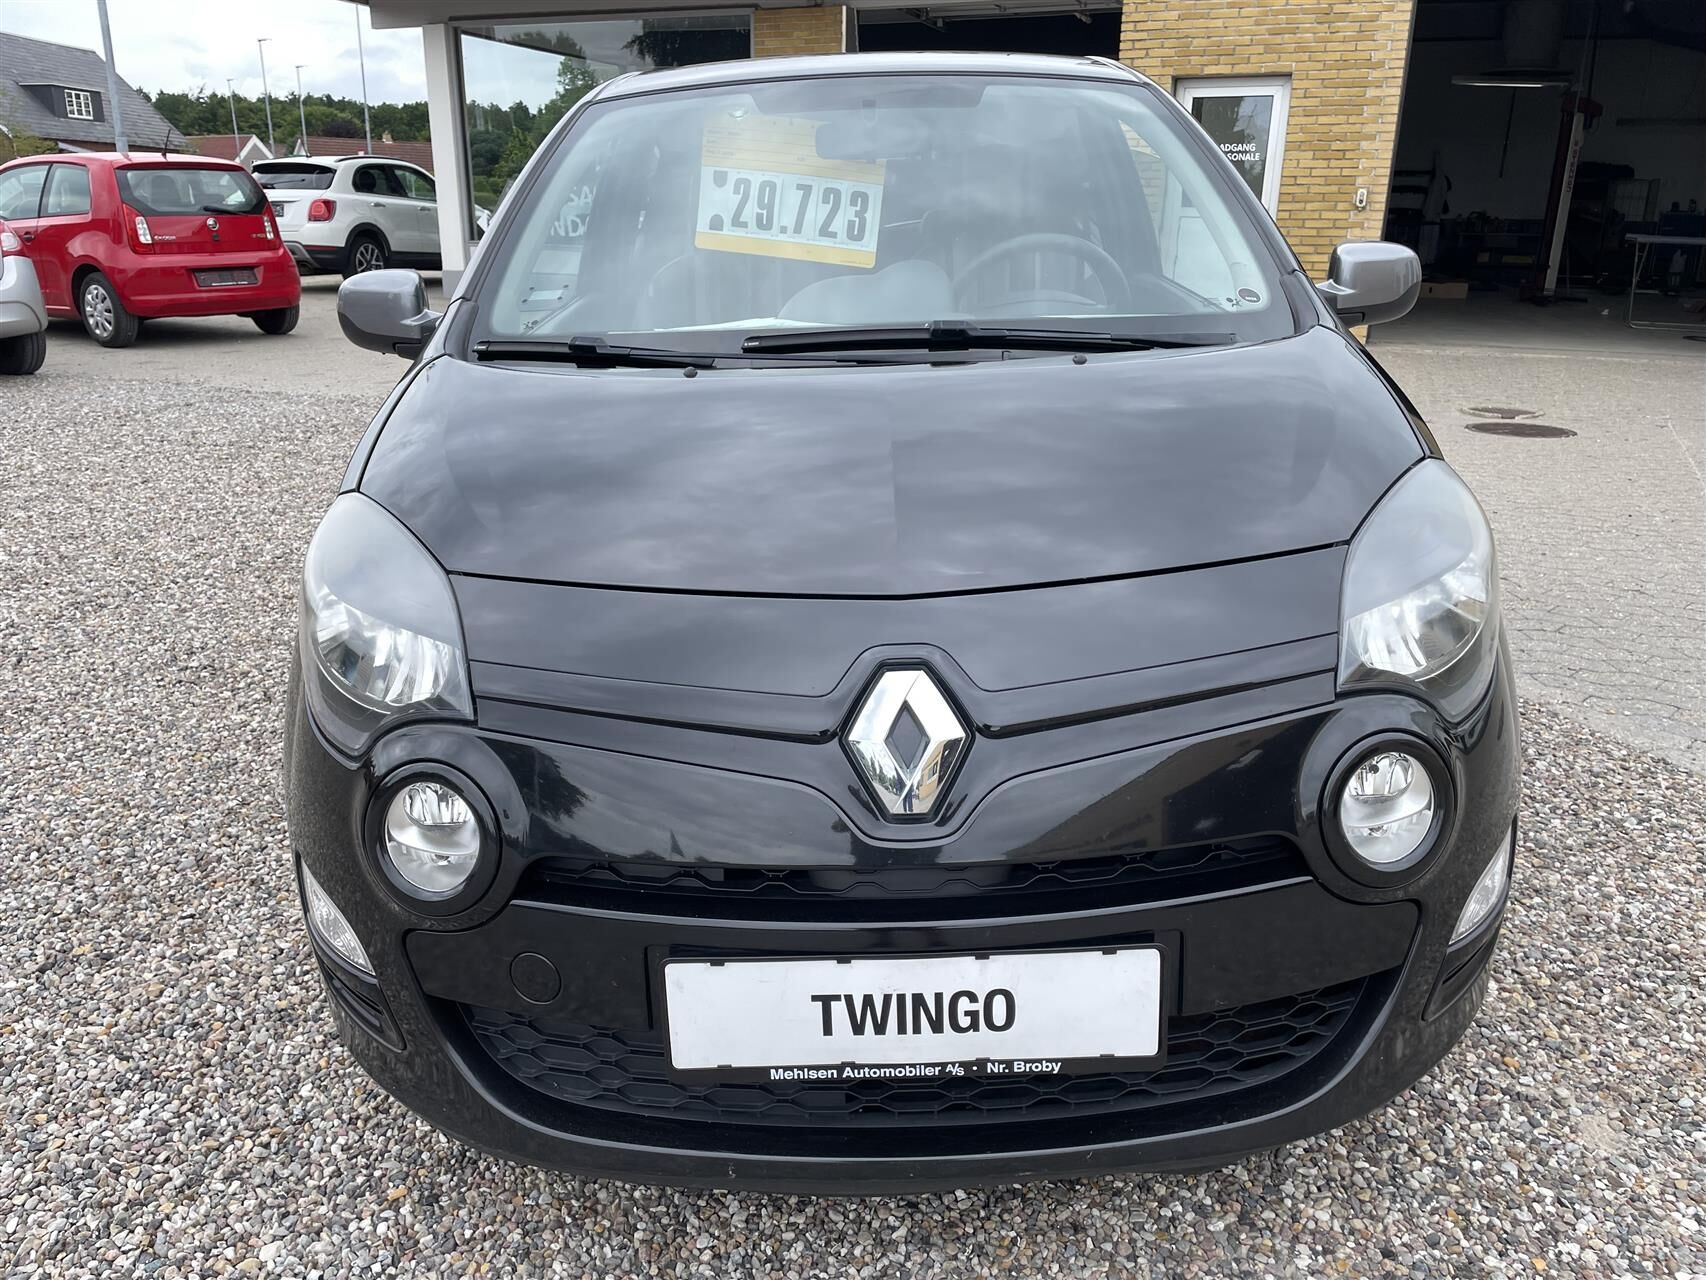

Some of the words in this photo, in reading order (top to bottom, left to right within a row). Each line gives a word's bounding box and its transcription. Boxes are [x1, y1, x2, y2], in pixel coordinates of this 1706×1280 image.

[731, 177, 870, 242] 29.723
[810, 988, 1017, 1037] TWINGO
[769, 1067, 838, 1081] Mehlsen
[842, 1064, 942, 1079] Automobiler
[986, 1062, 1010, 1074] Nr.
[1013, 1060, 1062, 1075] Broby
